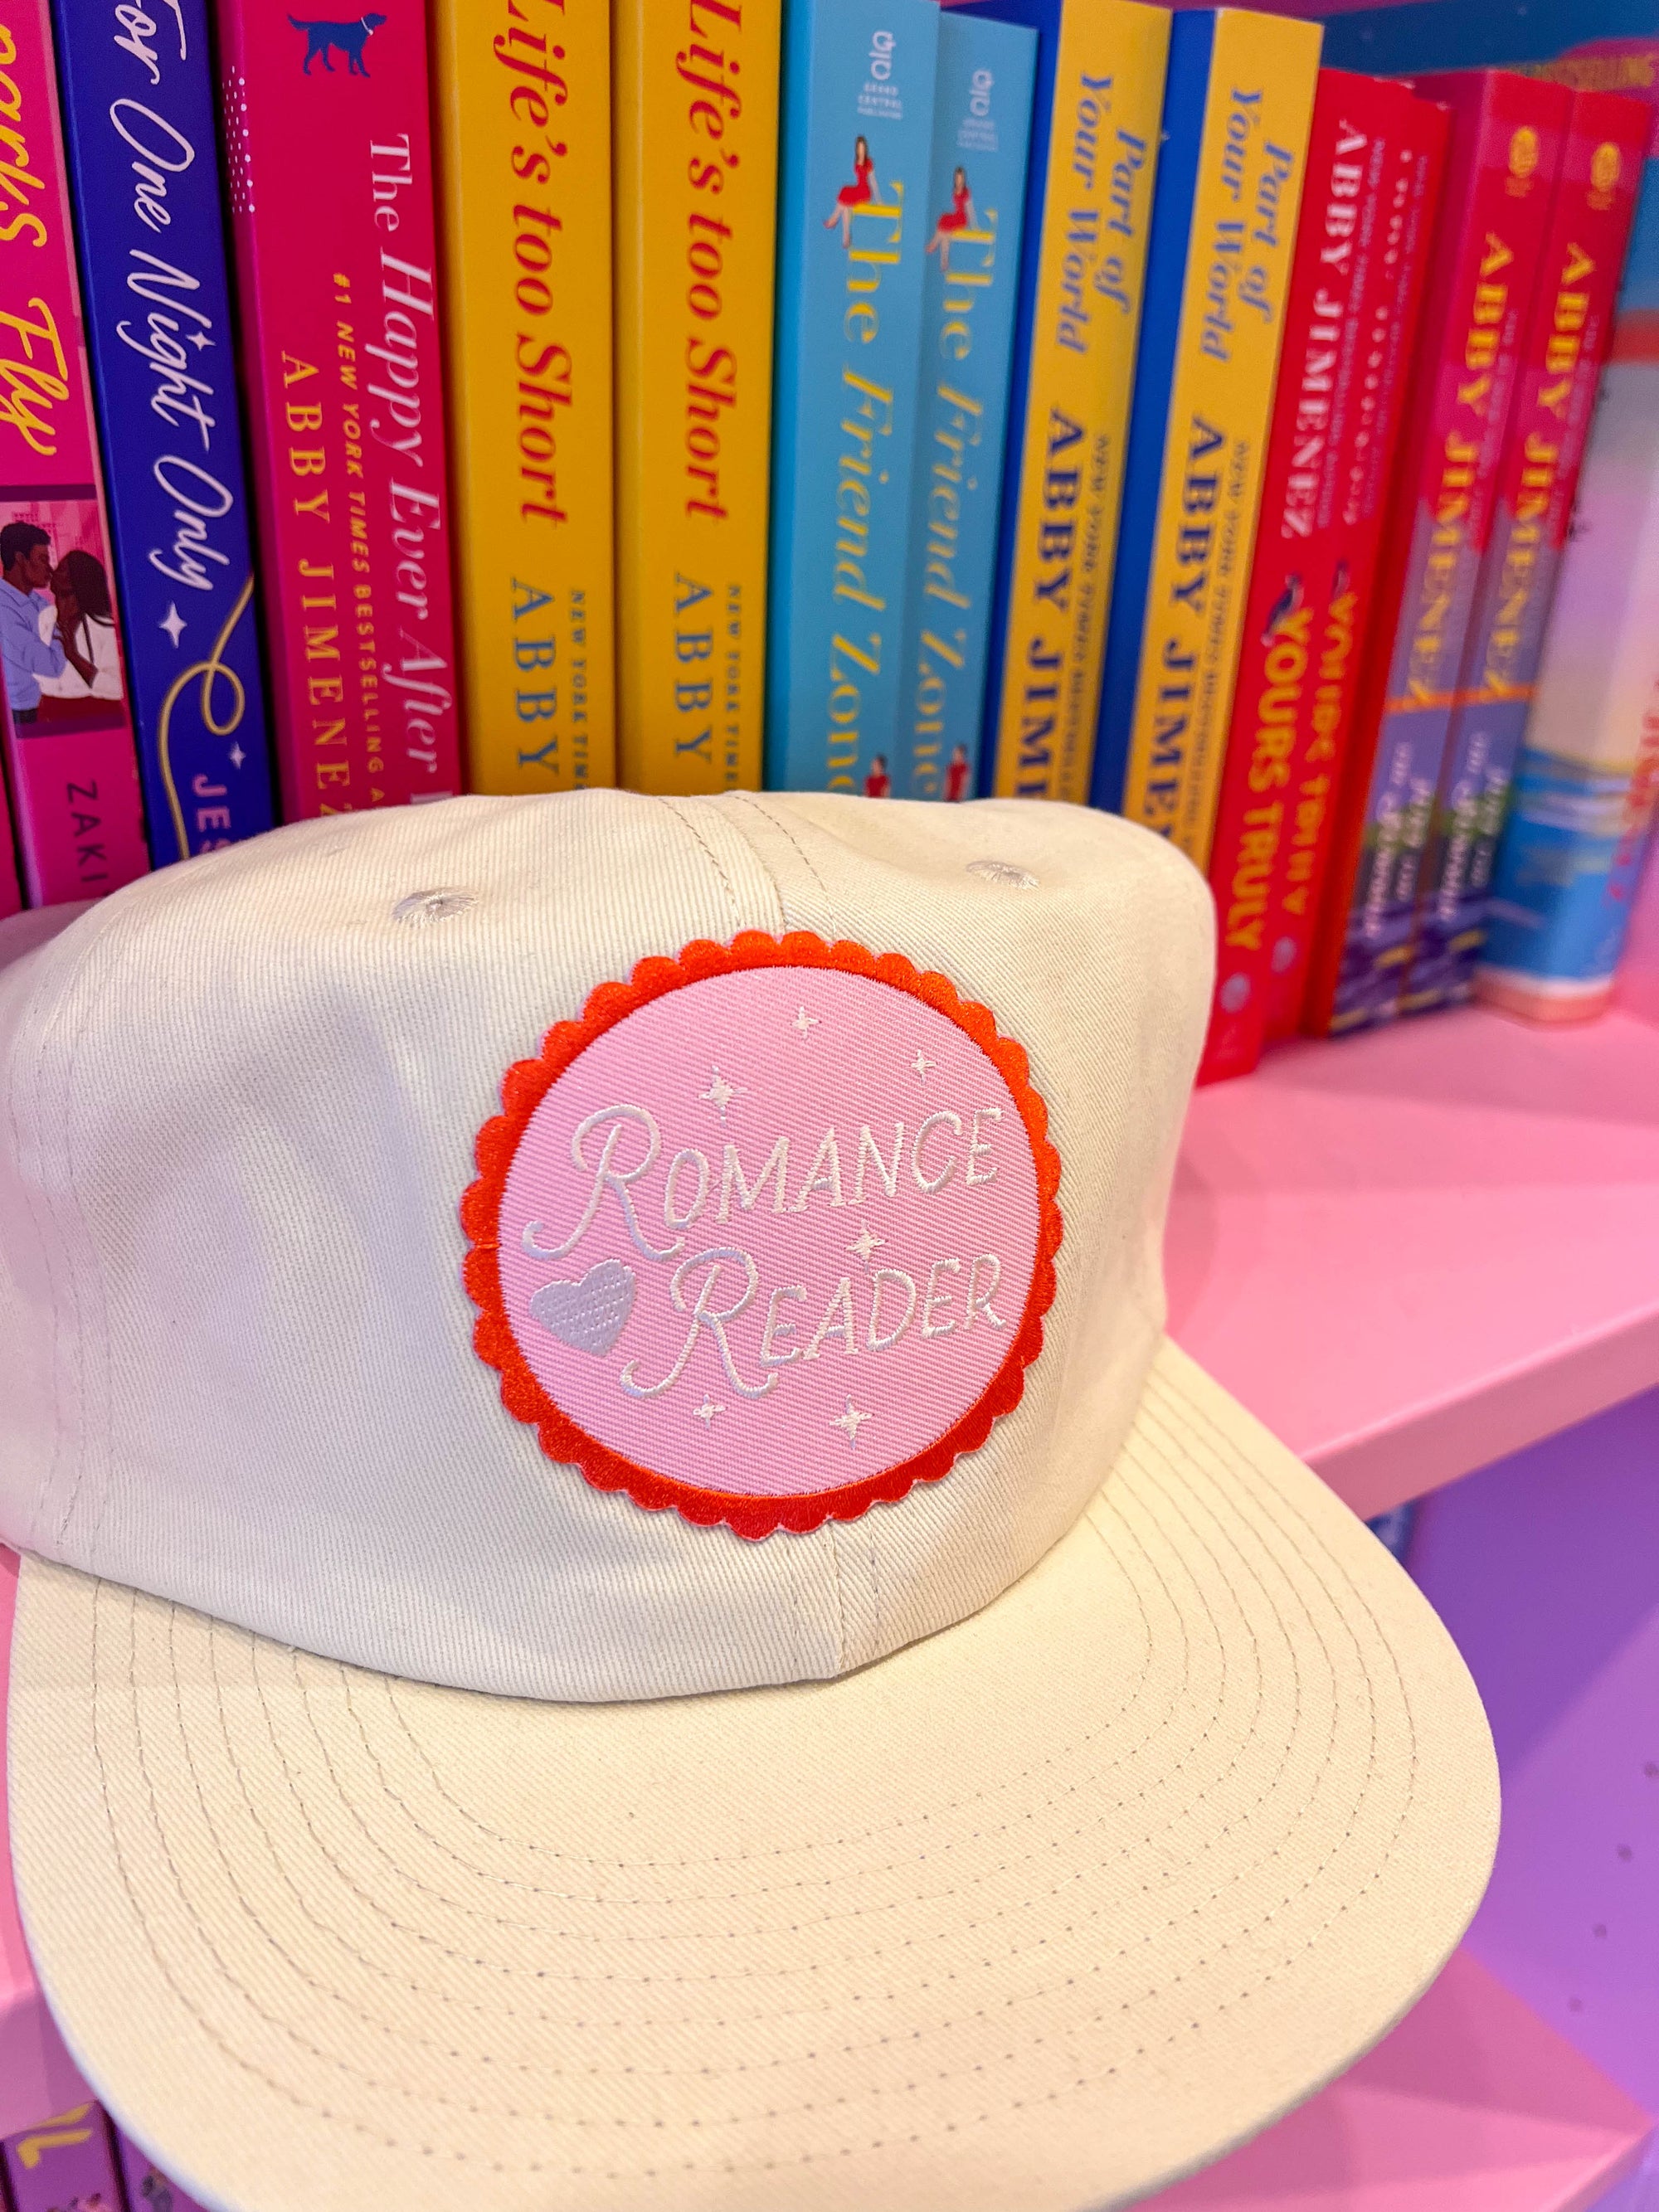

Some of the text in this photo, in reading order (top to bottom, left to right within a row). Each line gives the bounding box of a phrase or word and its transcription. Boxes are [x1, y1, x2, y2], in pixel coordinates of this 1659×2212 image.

[109, 99, 195, 233] One
[370, 134, 413, 232] The
[1055, 73, 1113, 354] Your World
[1094, 127, 1146, 314] Part of
[1200, 87, 1262, 362] Your World
[1237, 140, 1294, 323] Part of
[1321, 118, 1369, 276] ABBY
[333, 272, 352, 304] #1
[513, 203, 563, 317] too
[675, 0, 742, 525] Life's too Short
[843, 180, 904, 343] The
[938, 207, 998, 360] The
[1456, 232, 1515, 417] ABBY
[1536, 242, 1597, 420] ABBY
[0, 297, 70, 456] Fly
[116, 249, 216, 451] Night
[336, 321, 358, 391] NEW
[366, 246, 435, 467] Happy
[516, 332, 572, 528] Short
[1281, 287, 1344, 539] JIMENEZ
[281, 351, 331, 523] ABBY
[342, 401, 364, 479] YORK
[834, 362, 894, 611] Friend
[925, 379, 985, 609] Friend
[1033, 407, 1085, 614] ABBY
[149, 455, 234, 591] Only
[348, 492, 370, 573] TIMES
[390, 477, 441, 620] Ever
[354, 584, 385, 773] BESTSELLING
[511, 577, 559, 775] ABBY
[572, 589, 586, 644] NEW
[572, 658, 588, 722] YORK
[674, 571, 714, 762] ABBY
[726, 651, 742, 712] YORK
[727, 584, 742, 636] NEW
[1143, 416, 1226, 838] ABBY JIME
[382, 627, 453, 773] After
[1226, 606, 1315, 952] YOURS TRULY
[66, 778, 114, 895] ZAKI
[522, 1104, 1005, 1259] ROMANCE
[620, 1247, 1009, 1399] READER
